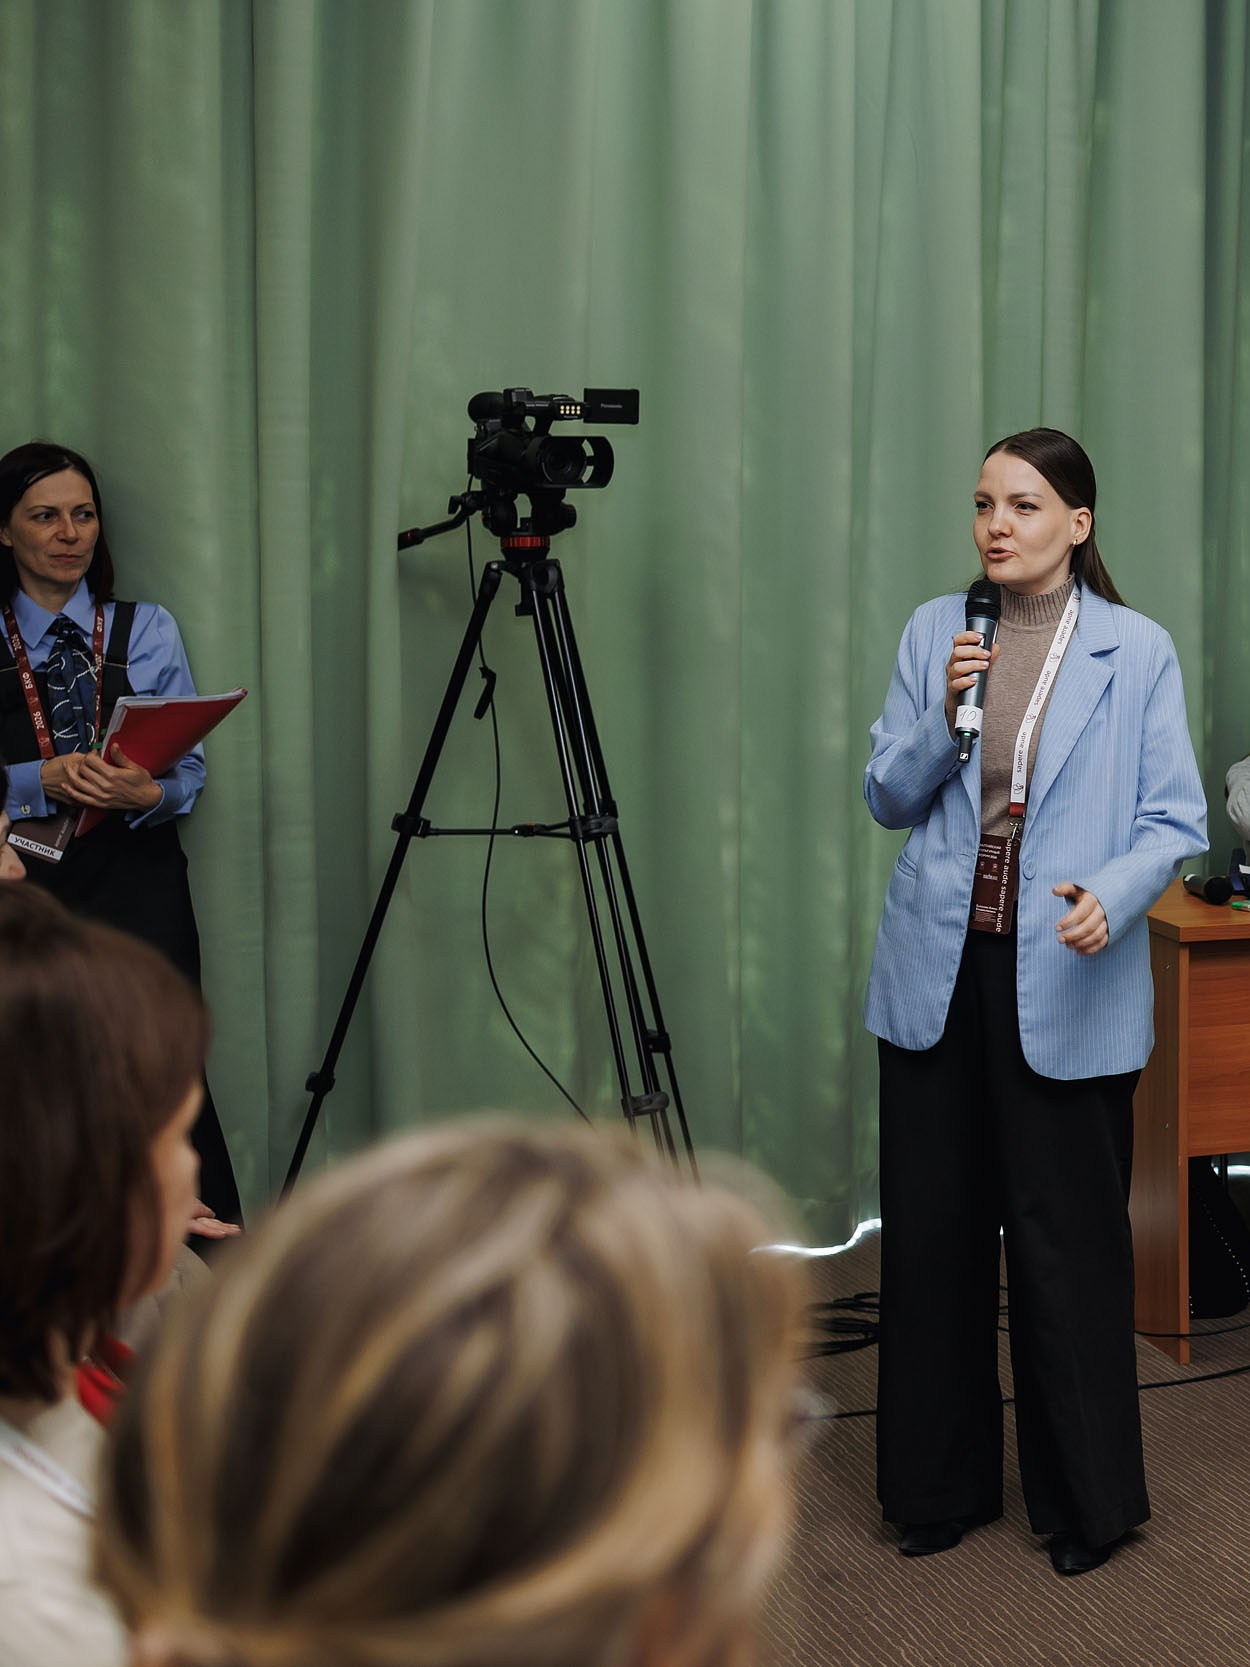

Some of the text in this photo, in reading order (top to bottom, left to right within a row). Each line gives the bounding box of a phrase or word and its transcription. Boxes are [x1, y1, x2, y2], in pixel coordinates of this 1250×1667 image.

[1057, 609, 1074, 645] sapere aude
[1034, 670, 1051, 706] sapere aude
[15, 837, 55, 856] УЧАСТНИК
[998, 886, 1007, 911] sapere
